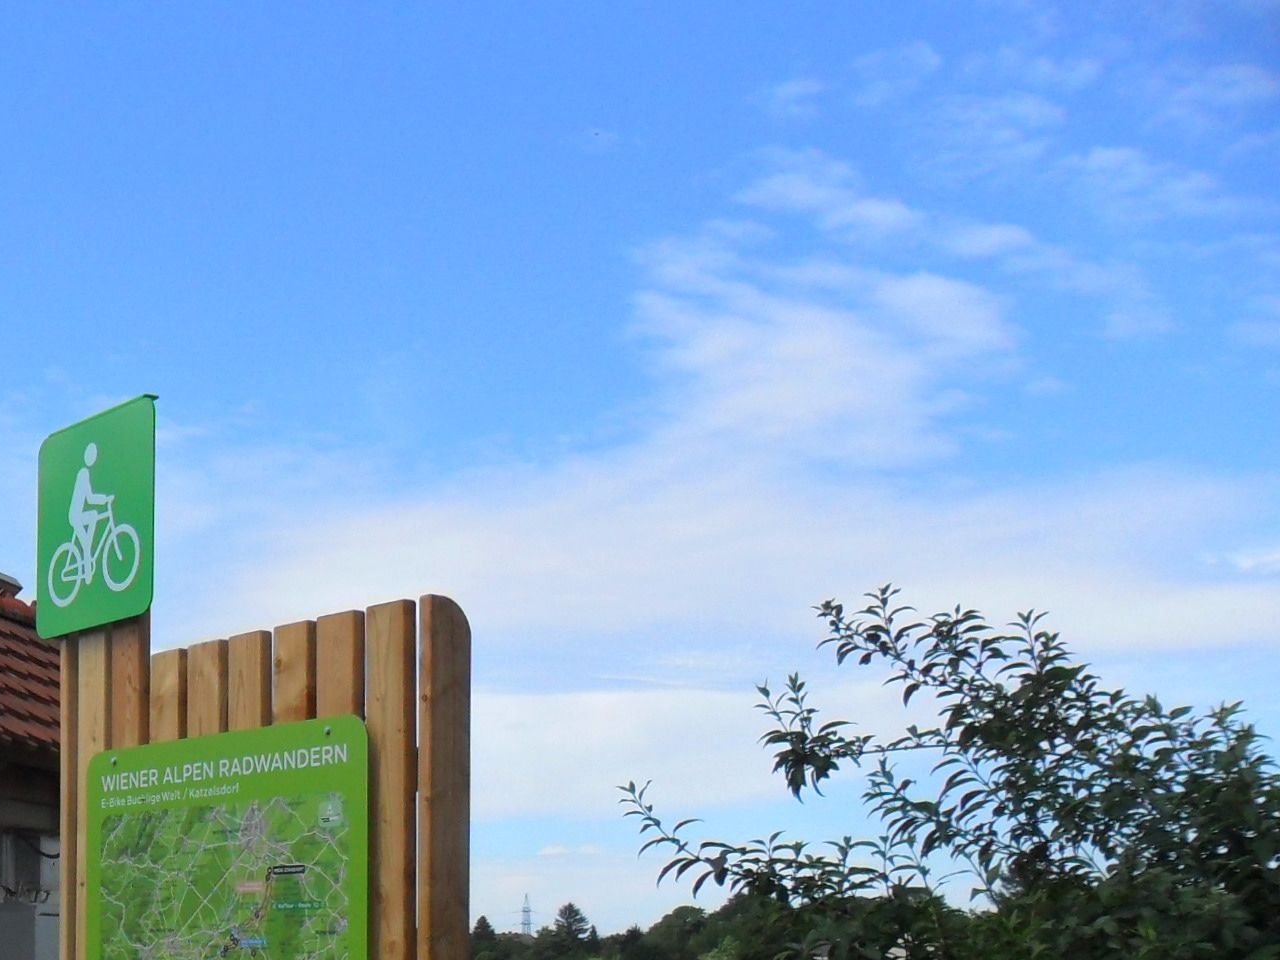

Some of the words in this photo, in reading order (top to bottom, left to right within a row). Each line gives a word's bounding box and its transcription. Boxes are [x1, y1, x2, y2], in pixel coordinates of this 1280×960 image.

[101, 769, 158, 792] WIENER
[163, 761, 213, 784] ALPEN
[219, 743, 348, 777] RADWANDERN
[100, 797, 126, 809] E-Bike
[161, 790, 181, 802] Welt
[189, 782, 240, 798] Katzelsdorf
